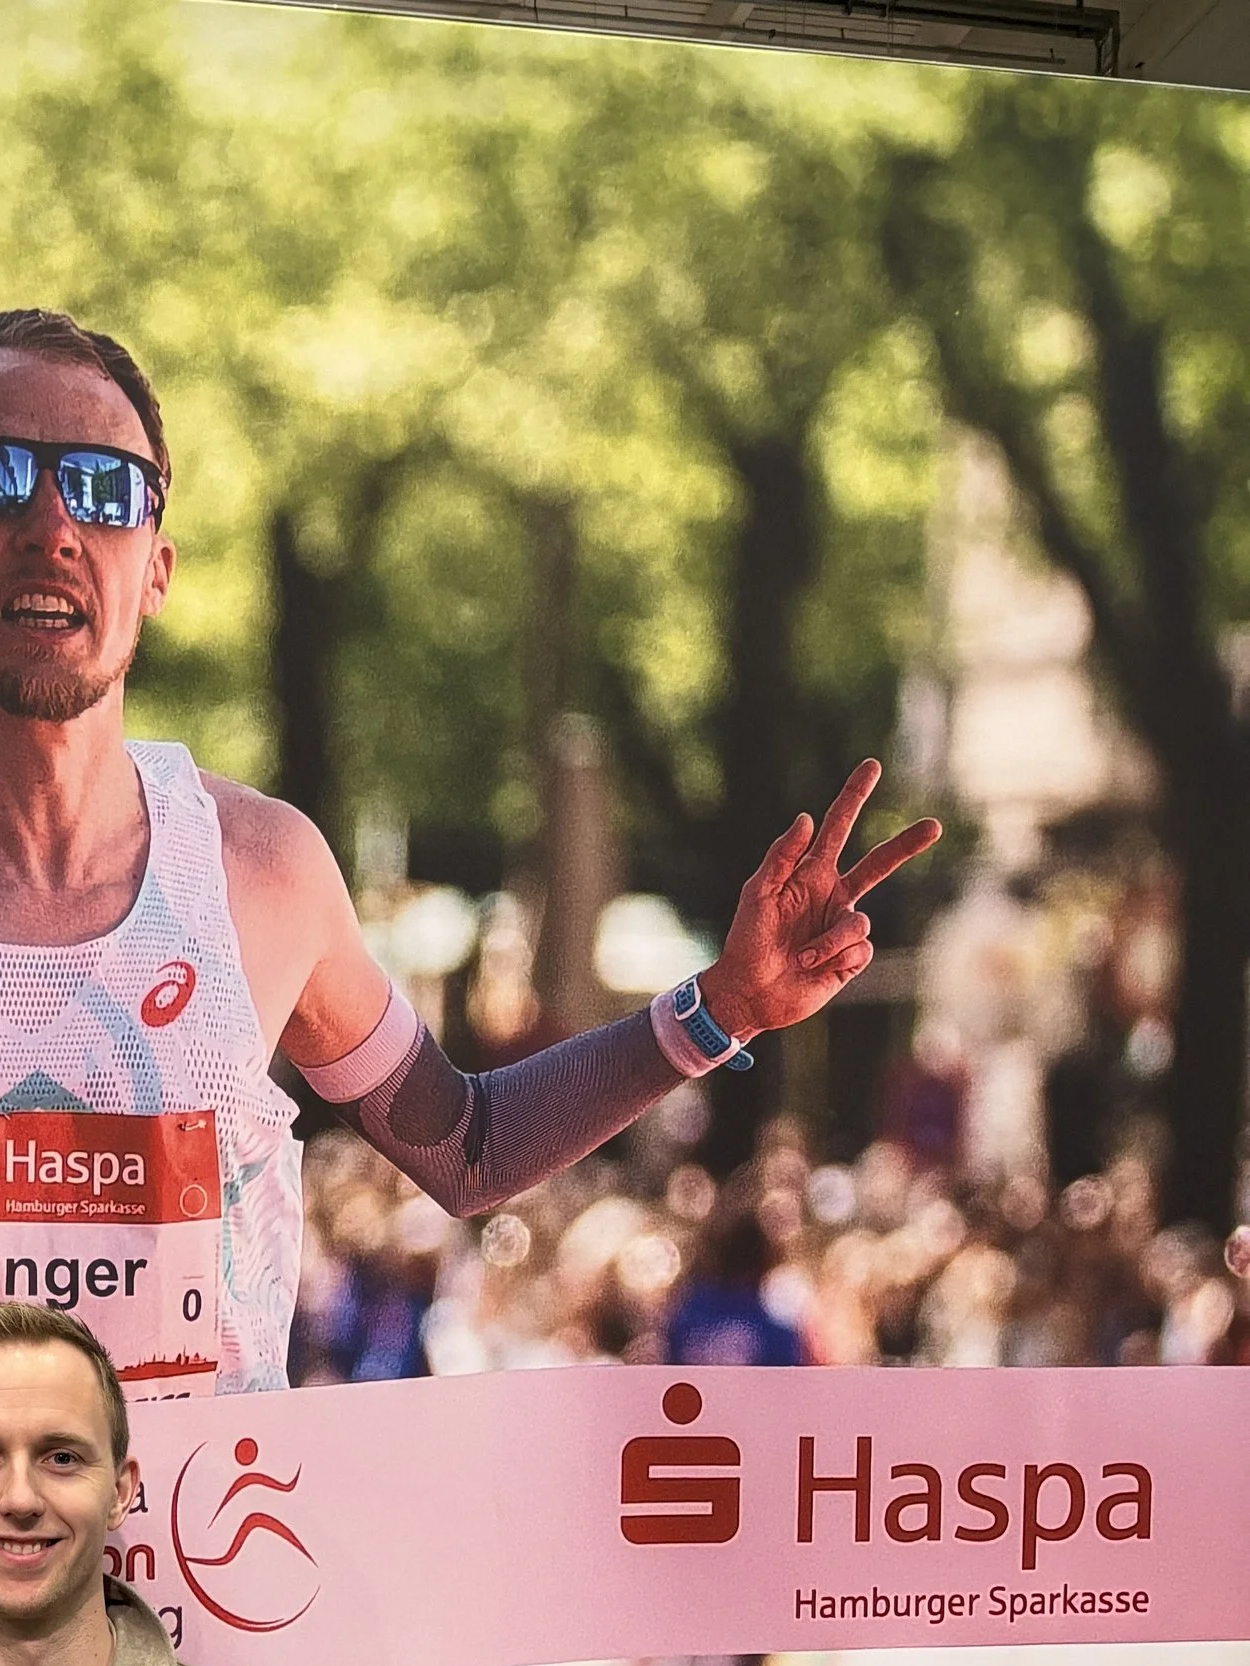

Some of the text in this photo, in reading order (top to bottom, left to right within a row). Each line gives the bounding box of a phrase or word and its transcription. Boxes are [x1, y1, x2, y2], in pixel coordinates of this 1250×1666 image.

[6, 1140, 145, 1195] Haspa
[5, 1199, 145, 1217] Hamburger Sparkasse
[182, 1288, 202, 1322] 0
[796, 1436, 1152, 1570] Haspa
[795, 1584, 1150, 1625] Hamburger Sparkasse
